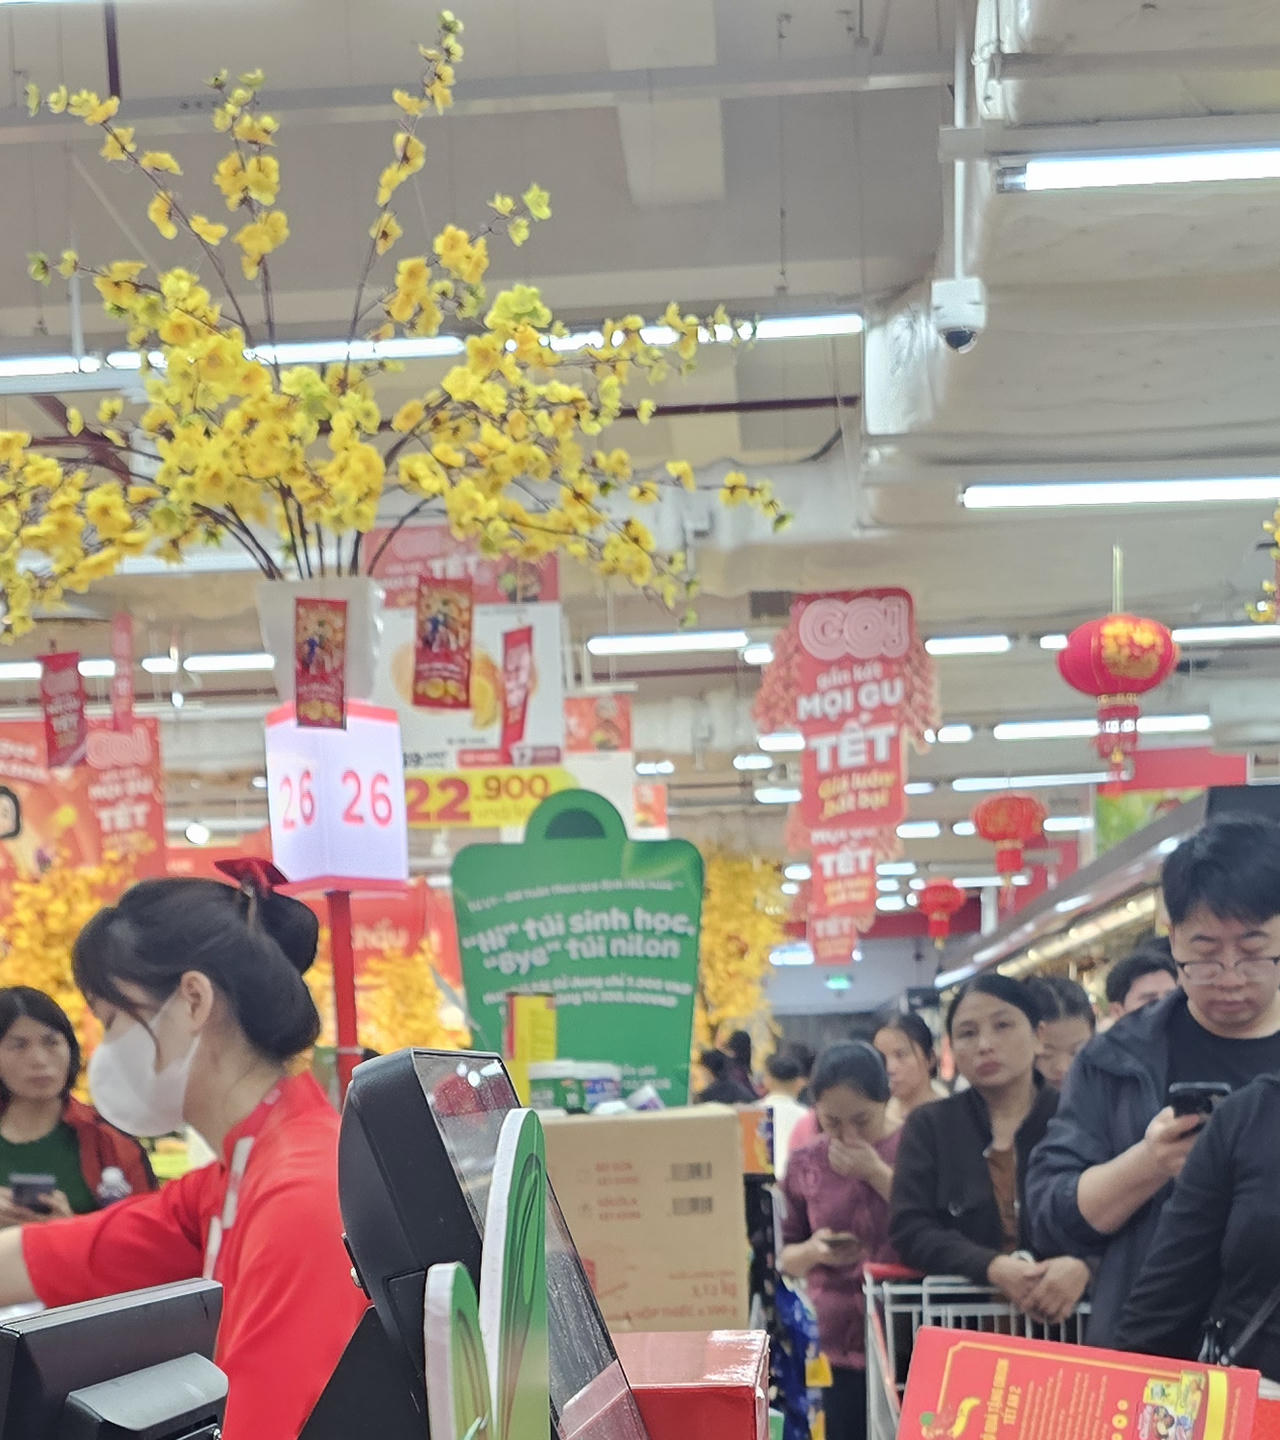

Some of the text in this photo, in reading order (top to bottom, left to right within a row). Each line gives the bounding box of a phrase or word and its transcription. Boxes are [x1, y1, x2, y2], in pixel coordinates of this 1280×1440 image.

[797, 678, 905, 722] MỌI GU
[808, 712, 898, 772] TẾT
[340, 768, 393, 827] 26
[405, 776, 470, 823] 22
[522, 913, 566, 940] túi
[568, 907, 630, 934] sinh
[633, 906, 696, 936] học,
[565, 935, 607, 960] túi
[610, 934, 680, 959] nilon
